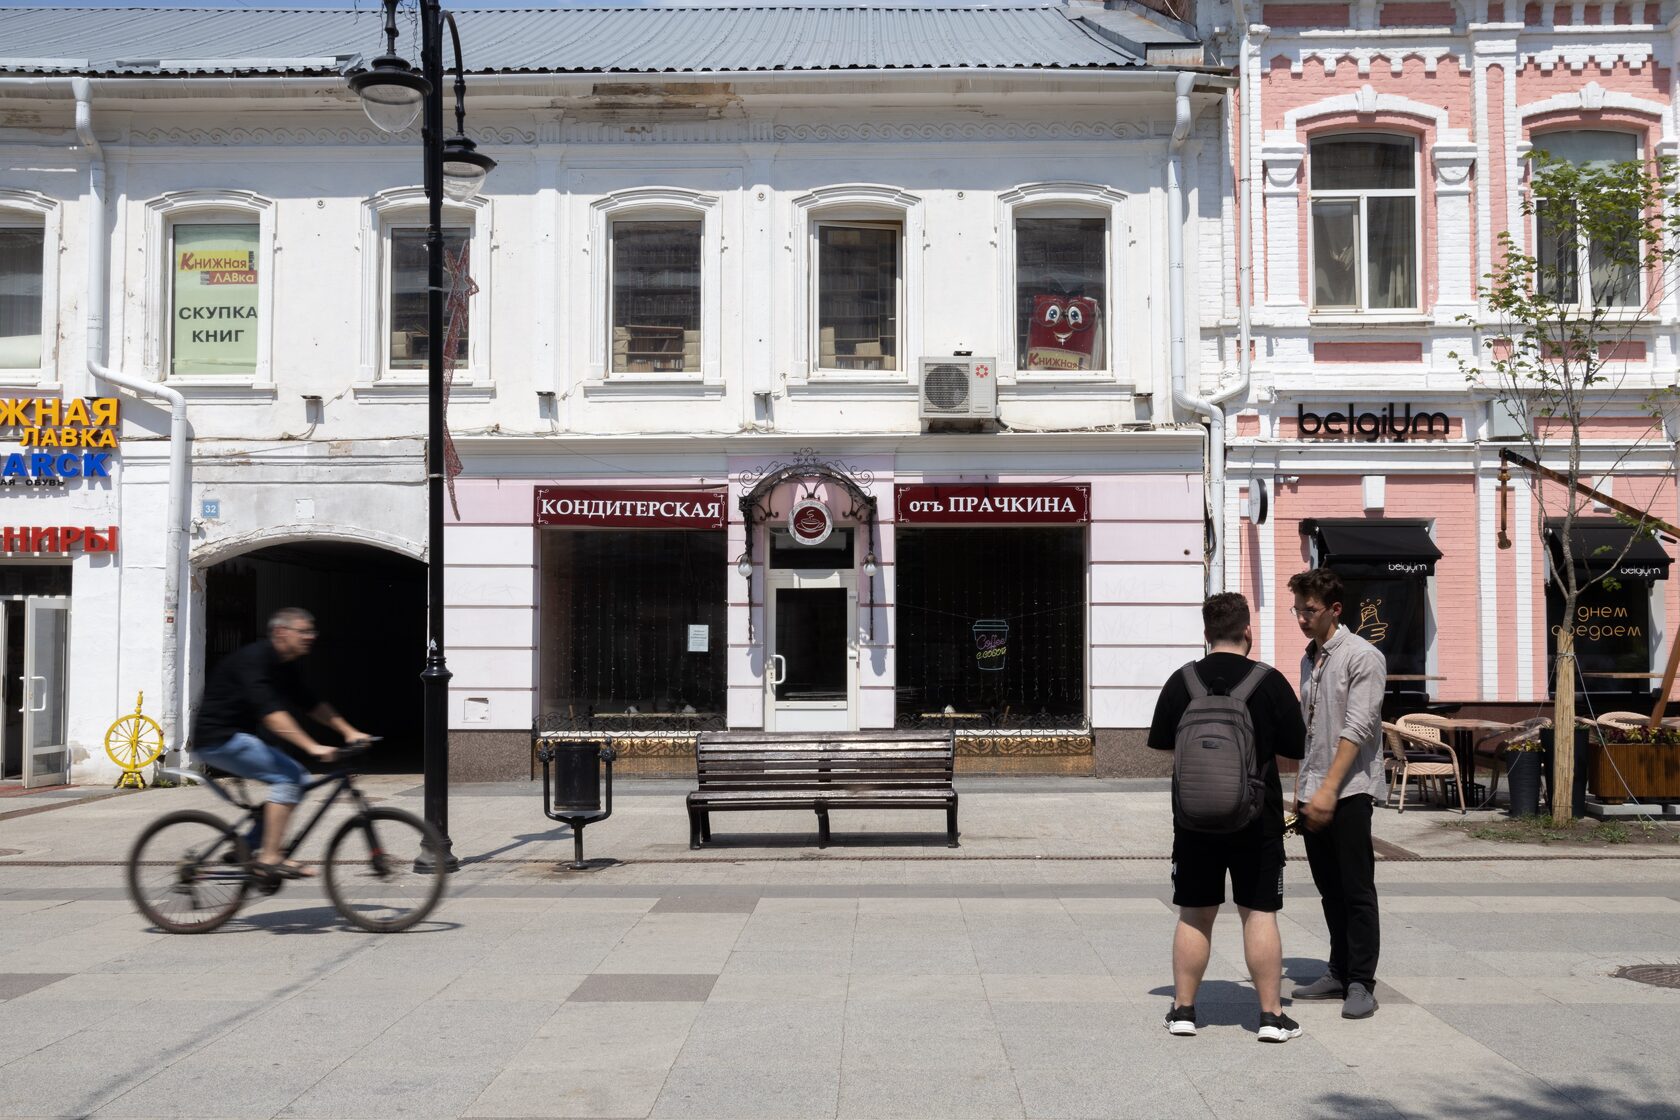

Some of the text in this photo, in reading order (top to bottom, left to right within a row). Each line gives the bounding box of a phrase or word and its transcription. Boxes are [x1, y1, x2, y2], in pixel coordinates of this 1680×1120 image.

[179, 306, 258, 320] СКУПКА
[192, 330, 245, 343] КНИГ
[0, 397, 119, 427] ЖНАЯ
[1298, 403, 1449, 442] belgium
[20, 427, 118, 448] ЛАВКА
[1, 453, 111, 478] ARCK
[25, 479, 66, 487] ОБУВЬ
[205, 504, 216, 514] 32
[540, 499, 720, 519] КОНДИТЕРСКАЯ
[909, 497, 1077, 513] отъ ПРАЧКИНА
[3, 525, 119, 553] НИРЫ
[1388, 562, 1427, 574] belgium
[1620, 565, 1661, 577] belgium
